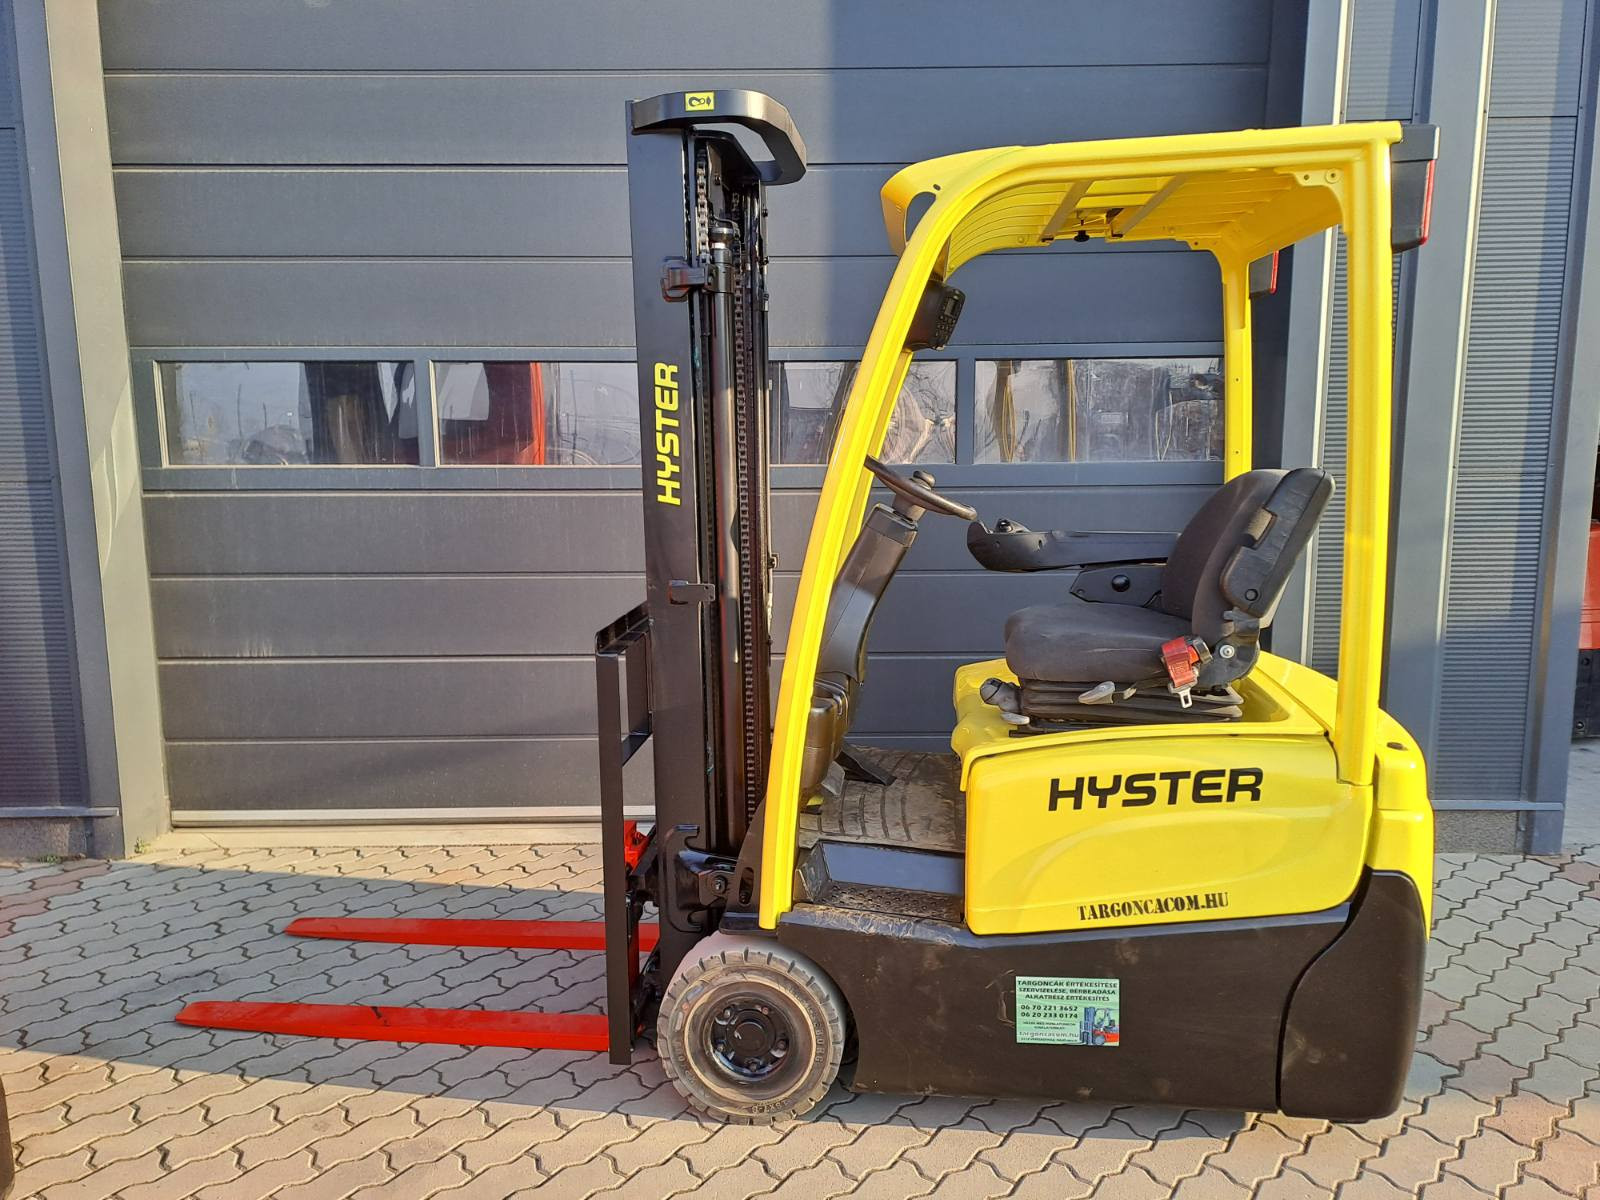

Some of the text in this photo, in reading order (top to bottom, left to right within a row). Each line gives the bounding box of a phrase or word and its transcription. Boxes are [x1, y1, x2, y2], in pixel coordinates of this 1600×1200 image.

[655, 362, 681, 505] HYSTER
[1048, 767, 1264, 811] HYSTER
[1077, 892, 1229, 921] TARGONCACOM.HU
